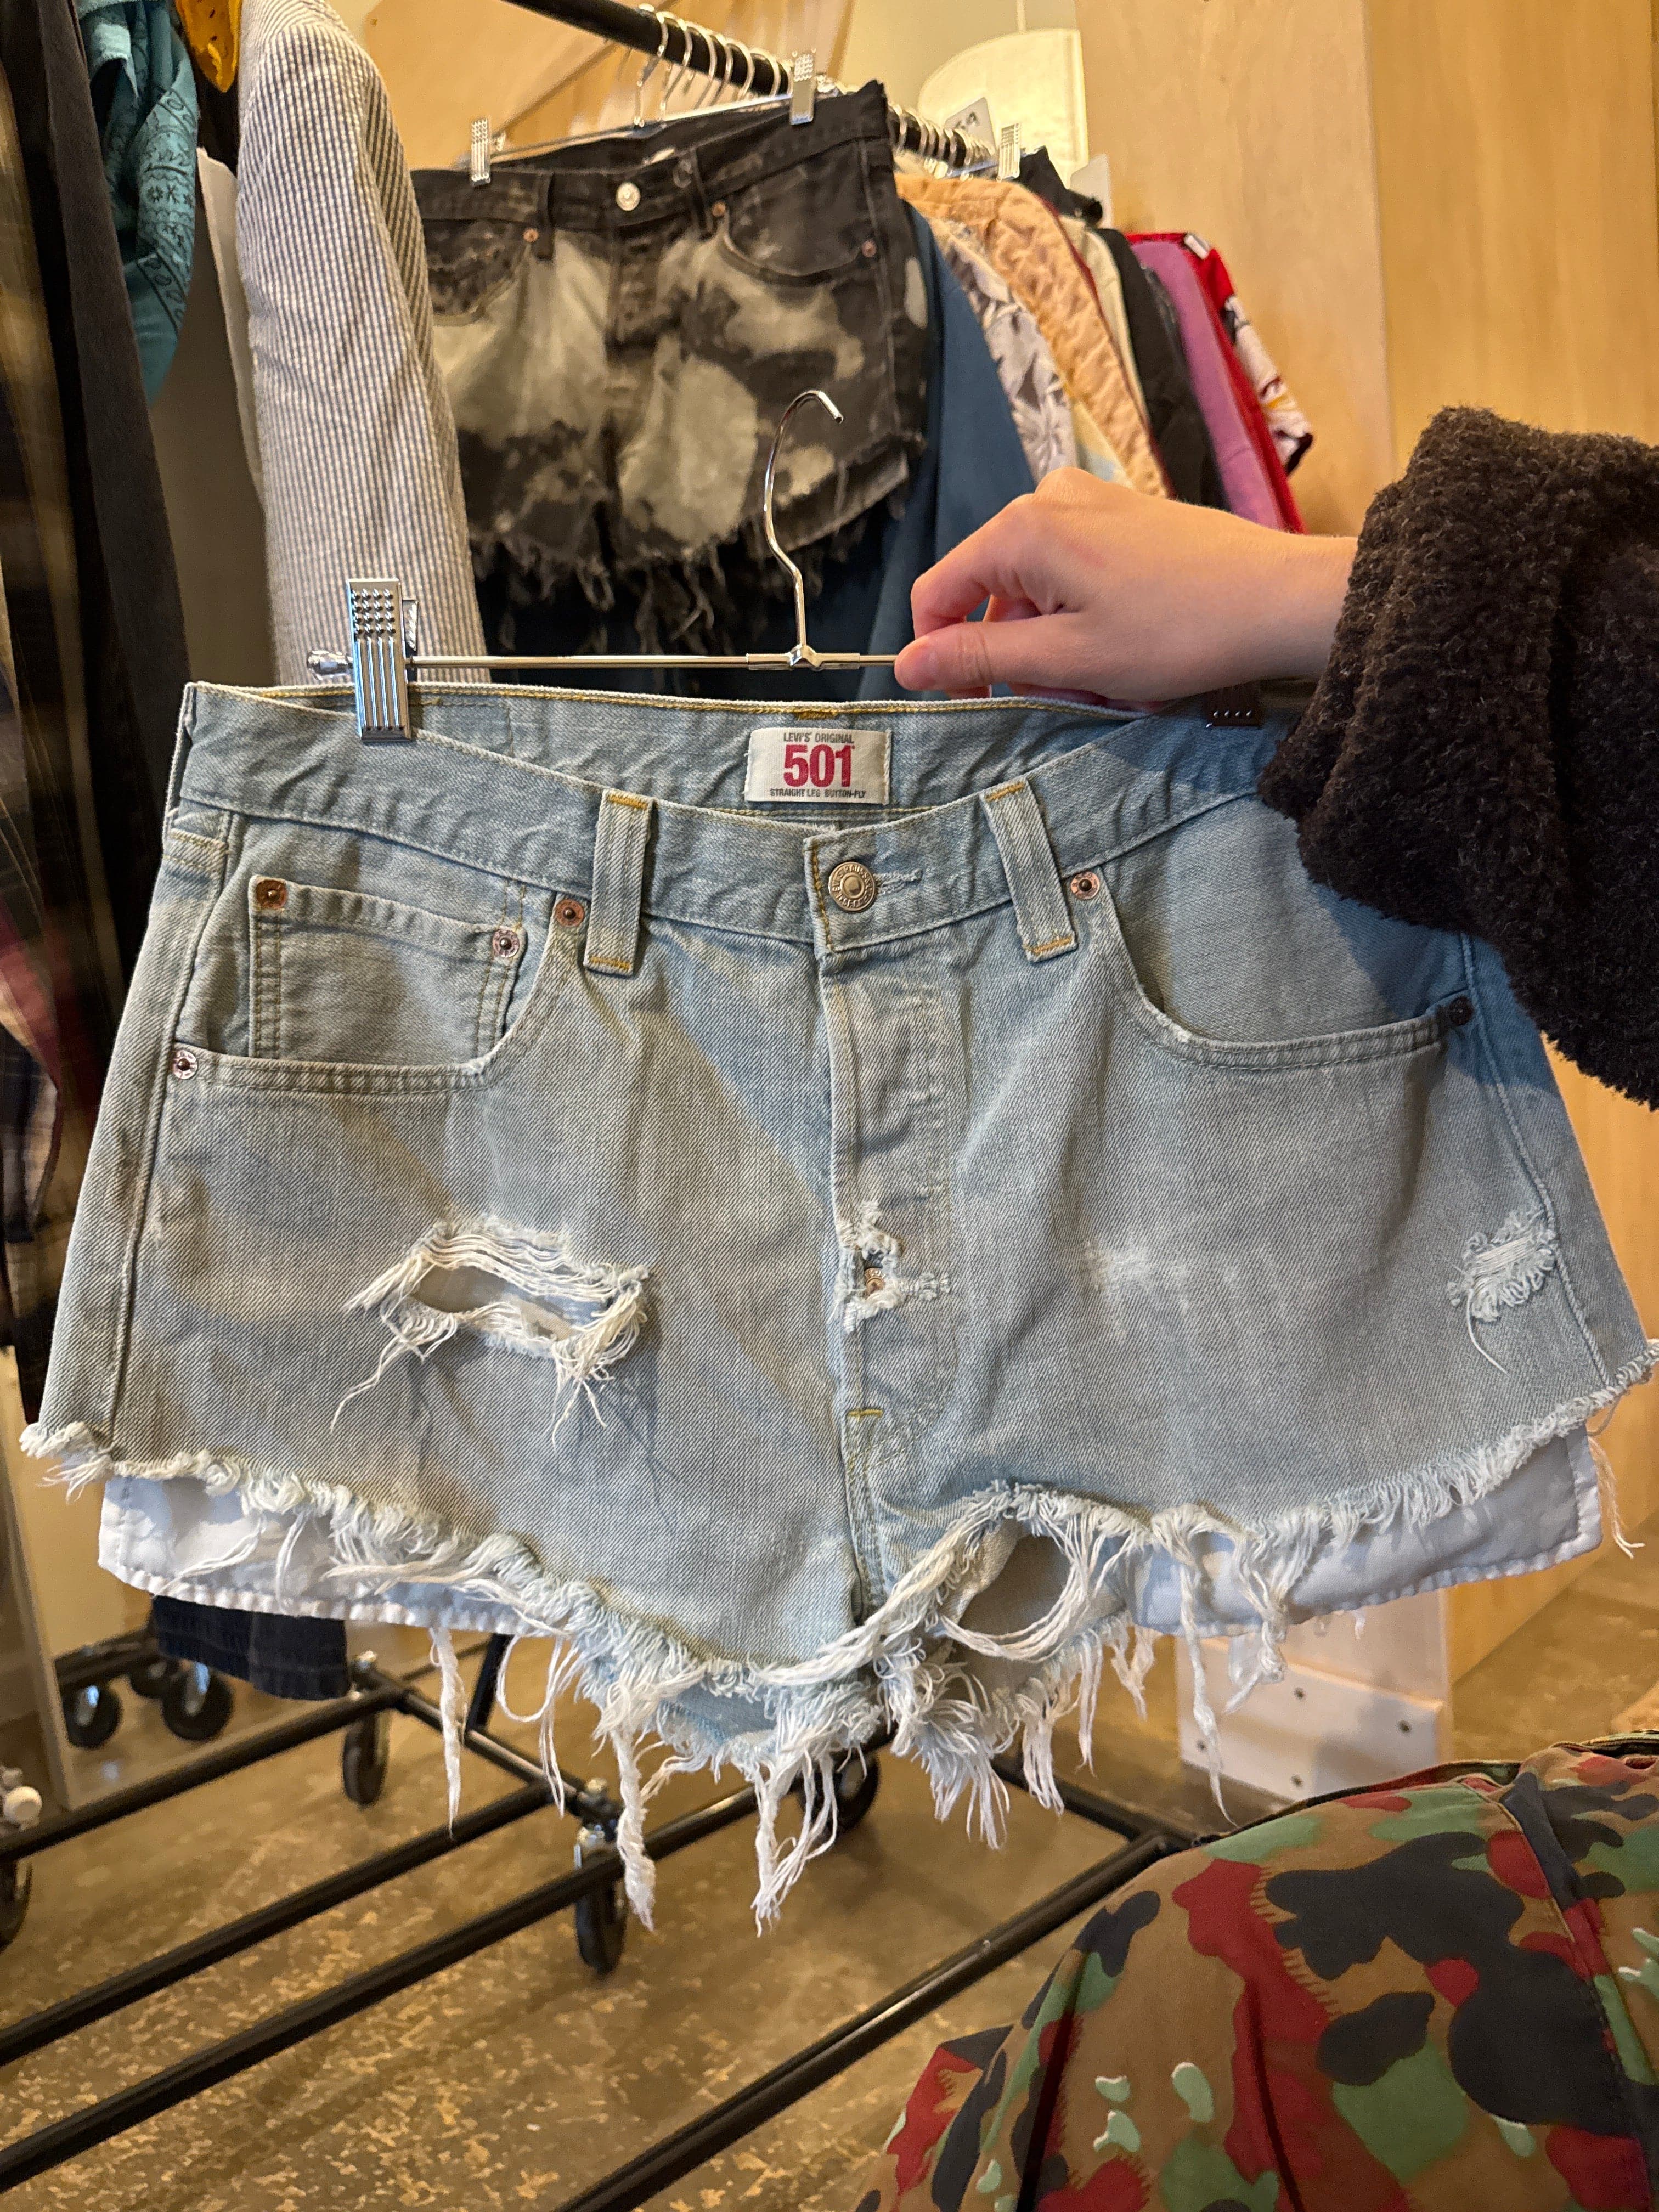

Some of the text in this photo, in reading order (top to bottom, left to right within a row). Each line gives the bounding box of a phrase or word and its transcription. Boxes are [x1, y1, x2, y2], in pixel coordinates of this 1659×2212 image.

[815, 733, 854, 743] ORIGINAL
[783, 744, 852, 787] 501
[770, 788, 866, 798] STRAIGHT LEG BUTTON-FLY
